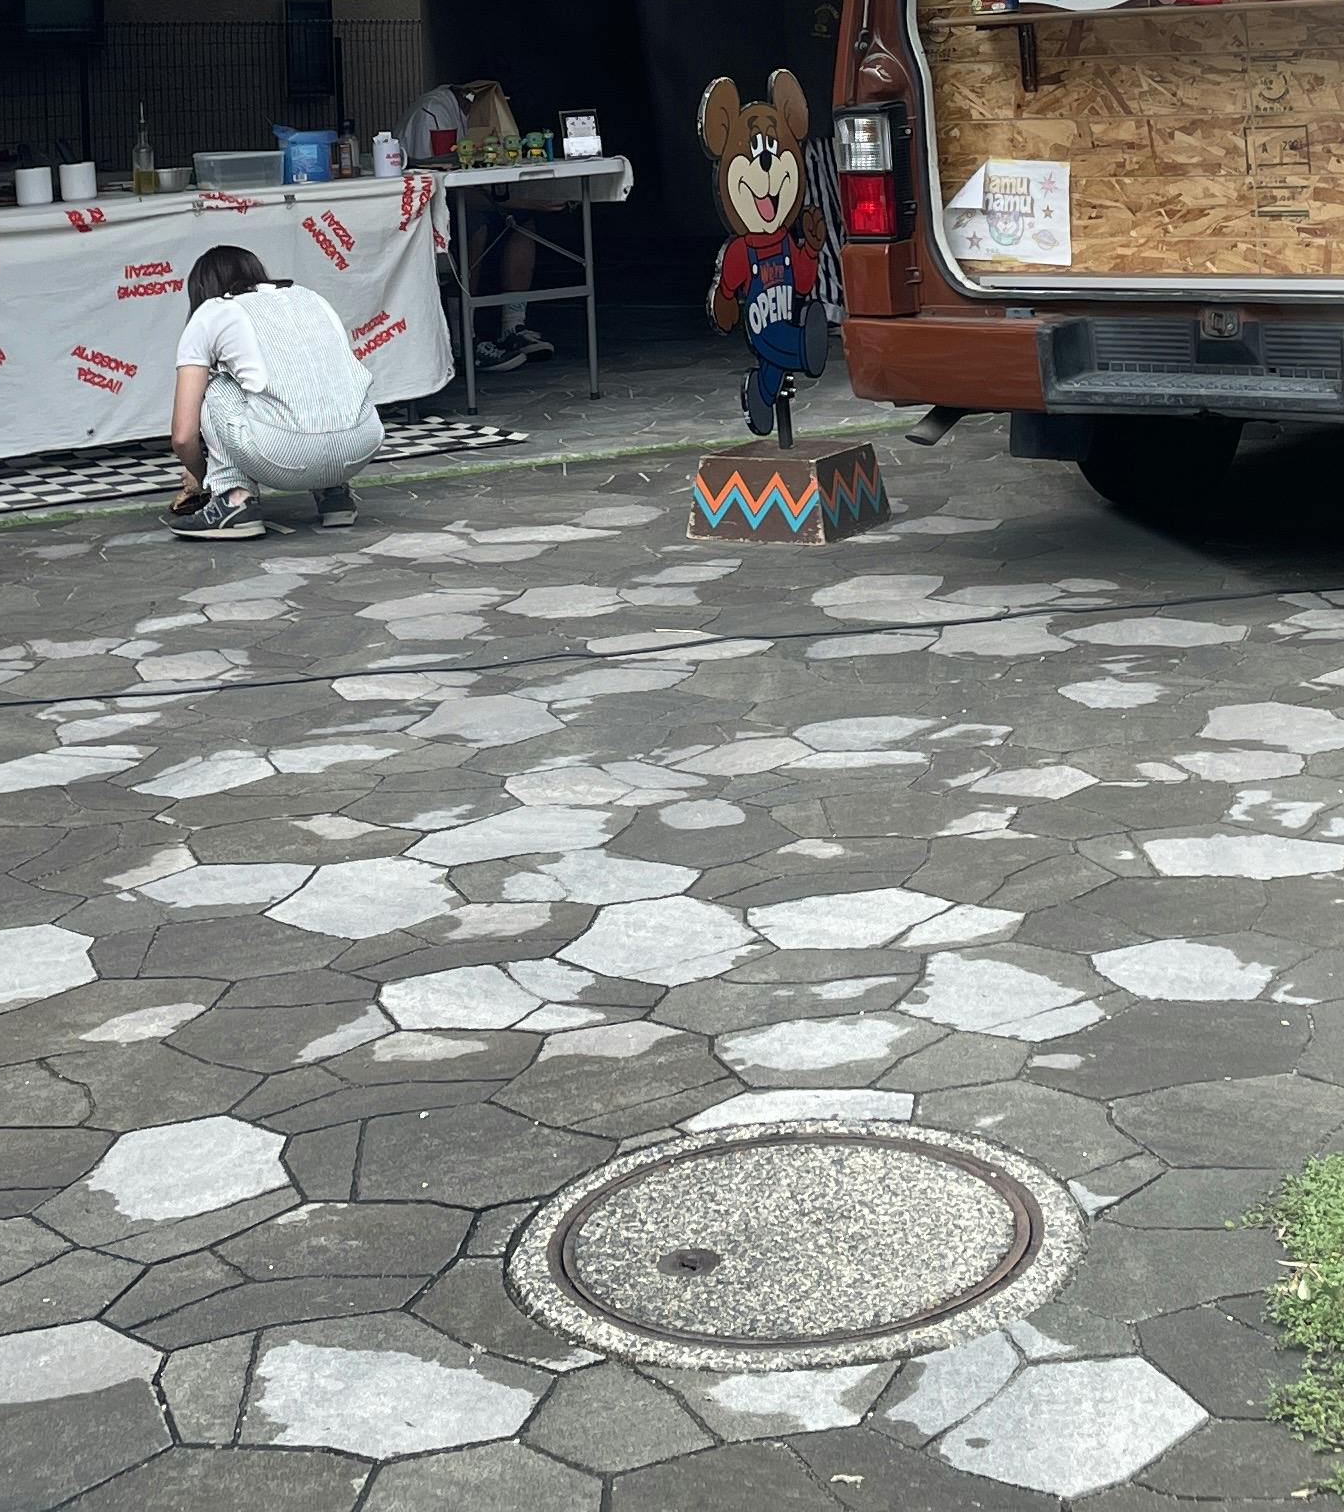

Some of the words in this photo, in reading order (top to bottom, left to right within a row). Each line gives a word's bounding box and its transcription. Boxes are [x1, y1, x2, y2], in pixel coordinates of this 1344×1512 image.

[989, 175, 1030, 194] amu
[302, 216, 350, 270] AWESOME
[117, 278, 184, 300] AWESOME
[749, 285, 792, 334] OPEN!
[71, 344, 138, 379] AWESOME
